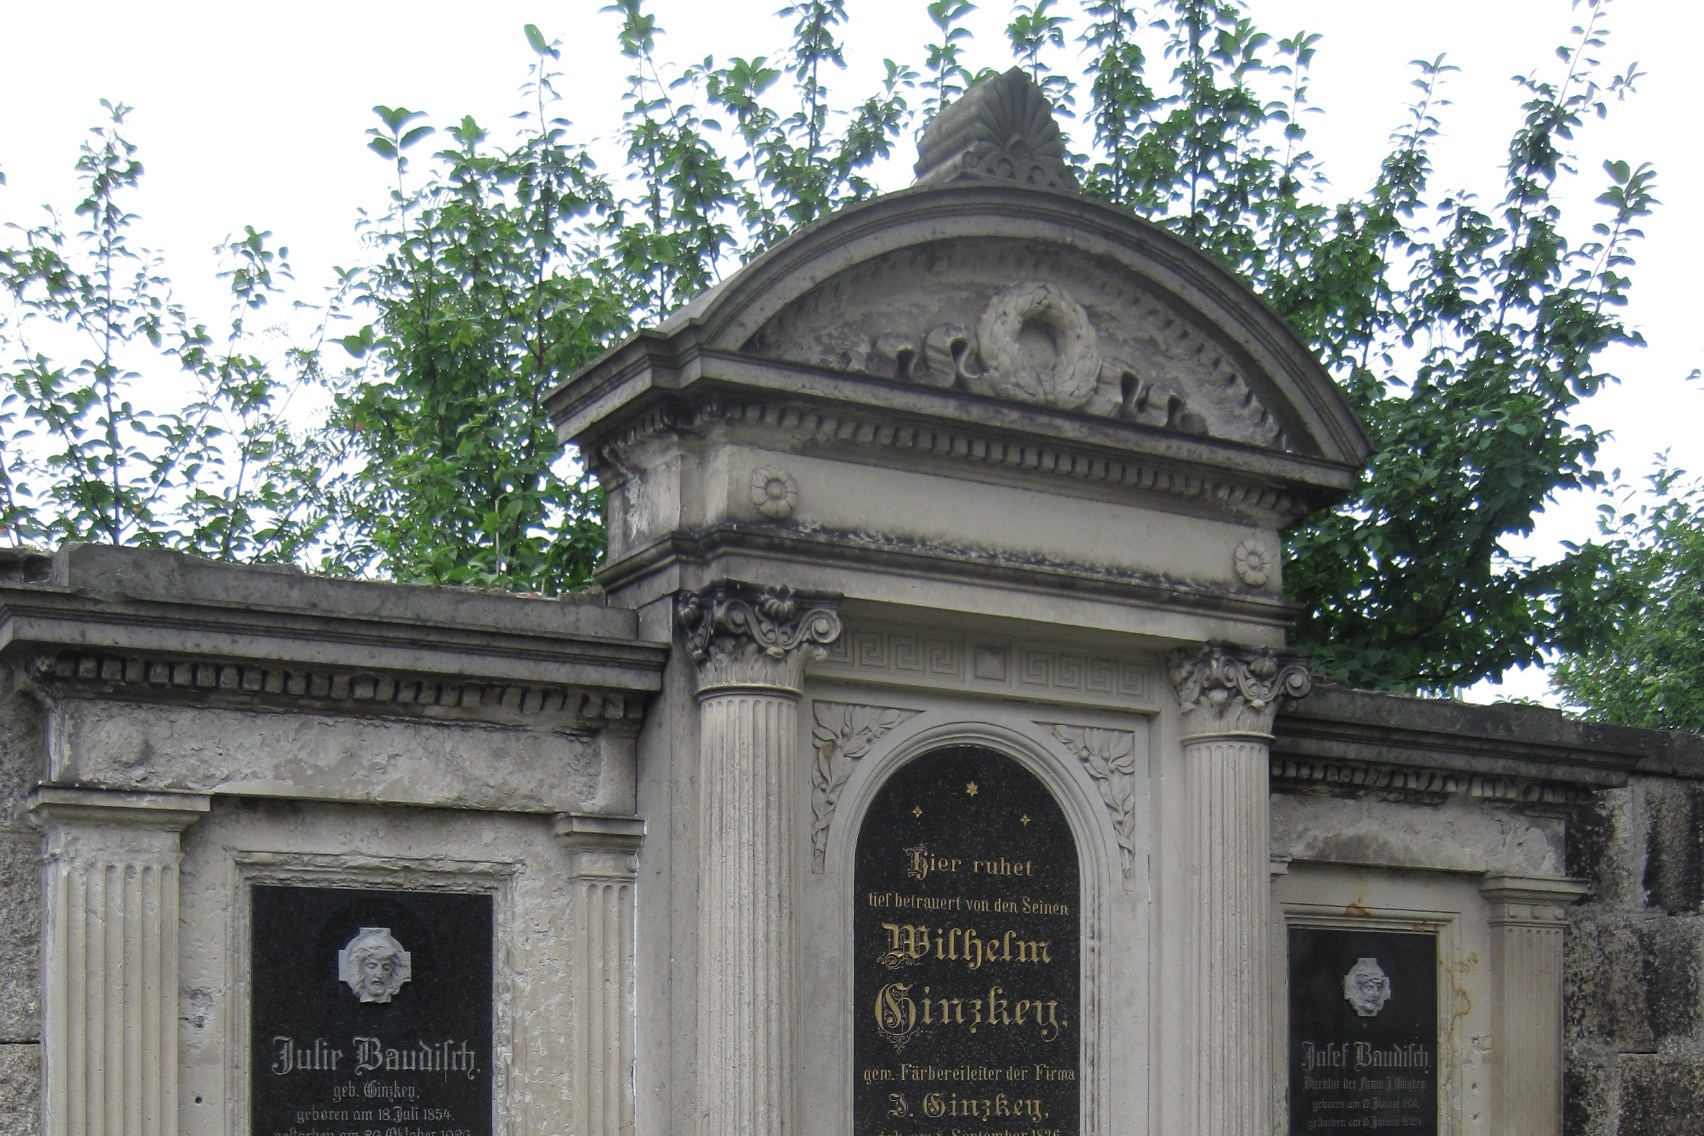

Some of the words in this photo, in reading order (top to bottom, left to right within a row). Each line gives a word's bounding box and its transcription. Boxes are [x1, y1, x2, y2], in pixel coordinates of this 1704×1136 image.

[903, 842, 962, 880] Hier
[973, 857, 1033, 877] ruhet
[869, 892, 892, 907] tief
[895, 893, 961, 911] betrauert
[965, 898, 989, 912] von
[994, 899, 1018, 914] den
[1022, 896, 1069, 916] Seinen
[877, 921, 1052, 970] Wilhelm
[271, 1035, 344, 1076] Julie
[863, 1068, 895, 1085] gew.
[901, 1063, 1002, 1081] Färbereileiter
[1006, 1065, 1028, 1081] der
[1034, 1063, 1076, 1081] Firma
[1343, 1077, 1357, 1090] der
[332, 1081, 360, 1102] geb.
[297, 1105, 349, 1123] geboren
[353, 1110, 373, 1121] am
[393, 1106, 419, 1124] Juli
[423, 1109, 455, 1121] 1854.
[1348, 1101, 1360, 1109] am
